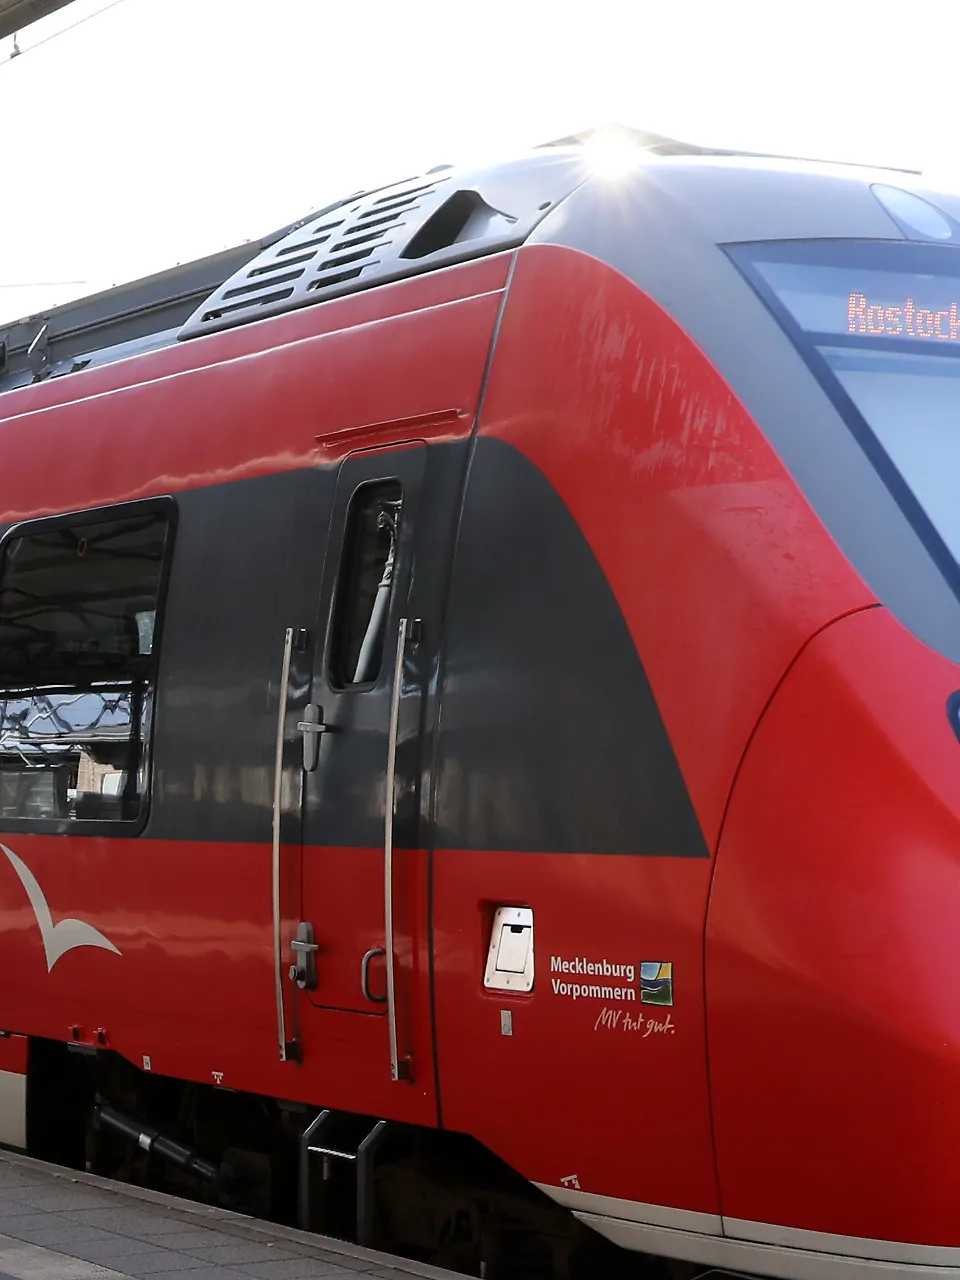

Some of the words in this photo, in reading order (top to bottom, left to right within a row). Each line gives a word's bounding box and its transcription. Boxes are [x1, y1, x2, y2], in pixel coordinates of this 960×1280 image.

[550, 956, 635, 982] Mecklenburg
[551, 978, 636, 1001] Vorpommern
[594, 1007, 621, 1031] MV
[623, 1012, 644, 1031] tut
